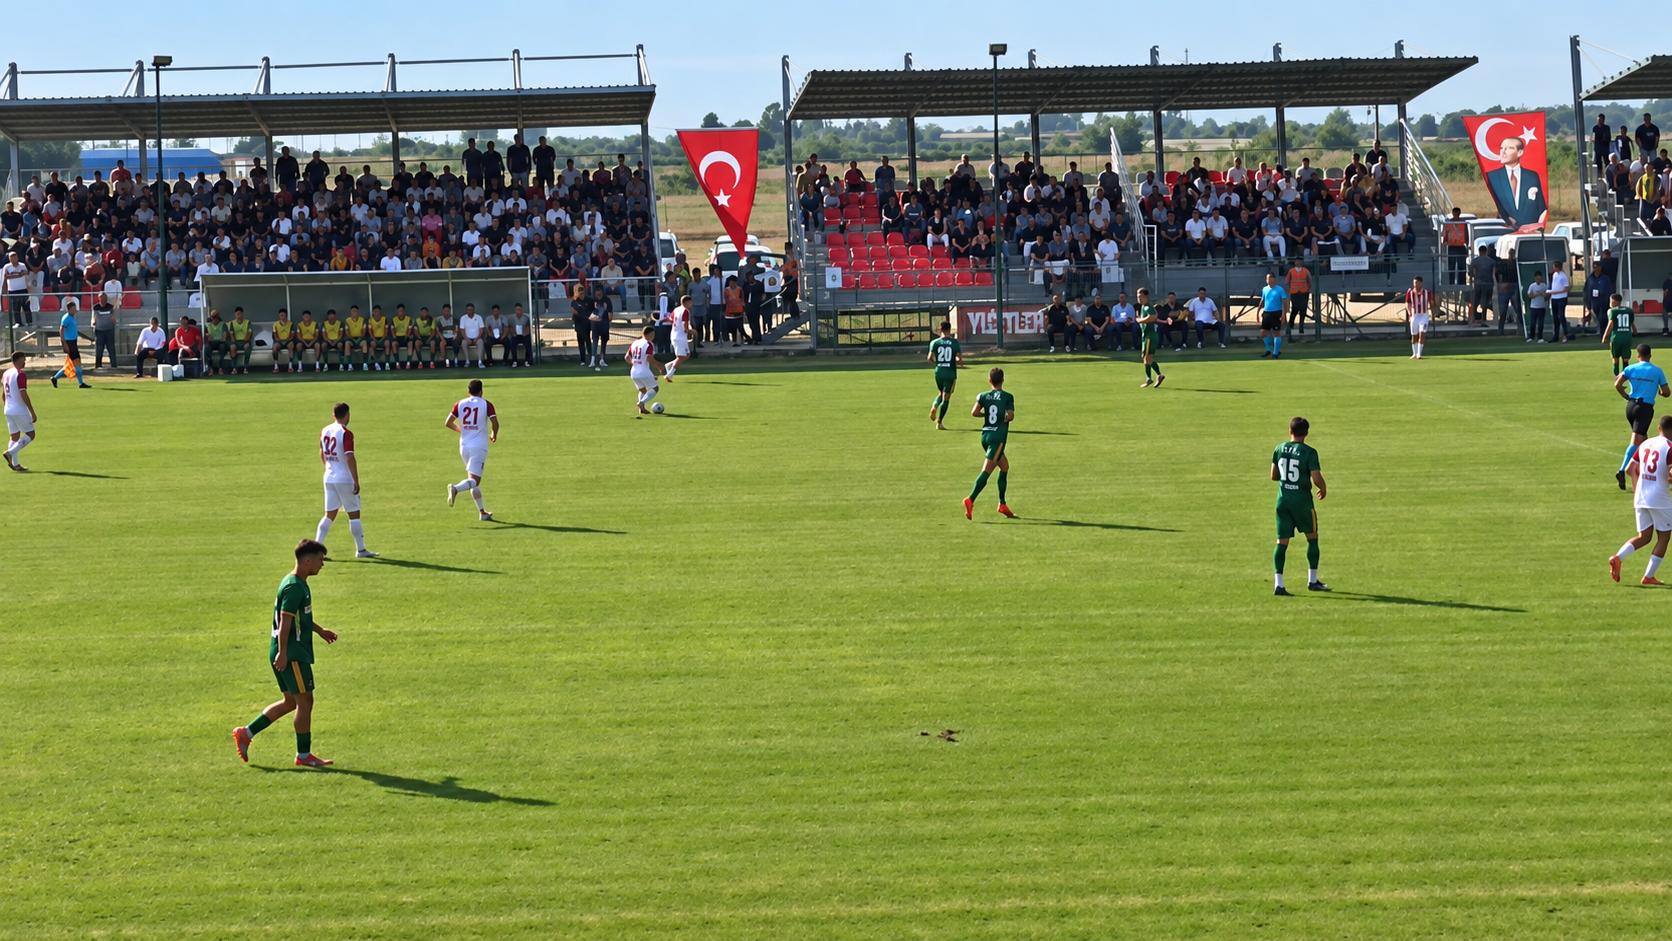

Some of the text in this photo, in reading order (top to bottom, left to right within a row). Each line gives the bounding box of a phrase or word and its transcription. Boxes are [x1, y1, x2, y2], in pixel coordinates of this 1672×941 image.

[1617, 313, 1629, 328] 10
[937, 346, 952, 362] 20
[462, 406, 479, 425] 21
[988, 404, 998, 425] 8
[1278, 457, 1300, 482] 15
[1643, 447, 1660, 474] 13
